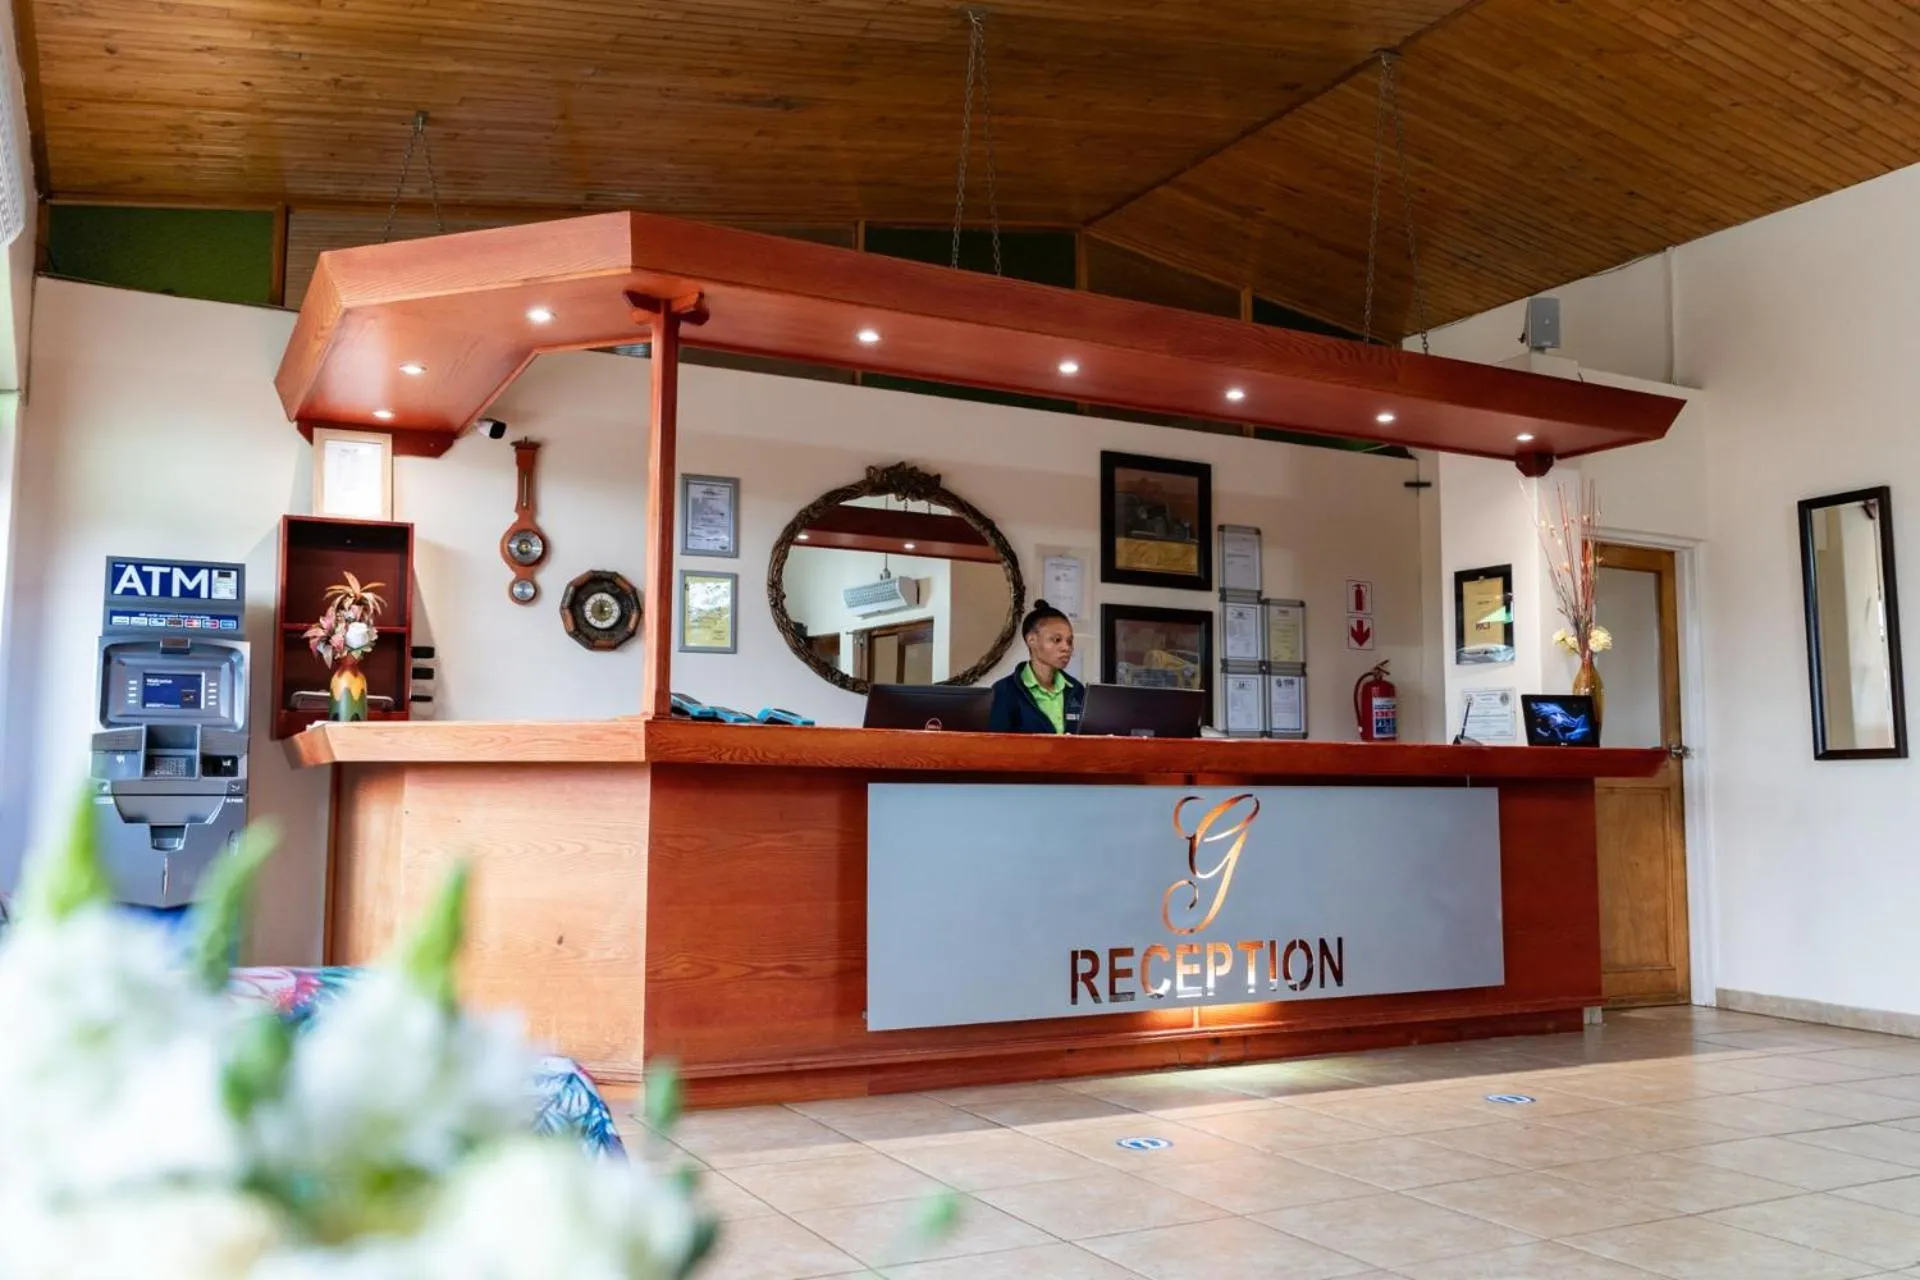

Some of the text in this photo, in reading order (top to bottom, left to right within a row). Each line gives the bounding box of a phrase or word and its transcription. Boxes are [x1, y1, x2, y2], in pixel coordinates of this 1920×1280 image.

[113, 564, 209, 599] ATM
[1161, 793, 1261, 936] G
[1069, 936, 1345, 1006] RECEPTION
